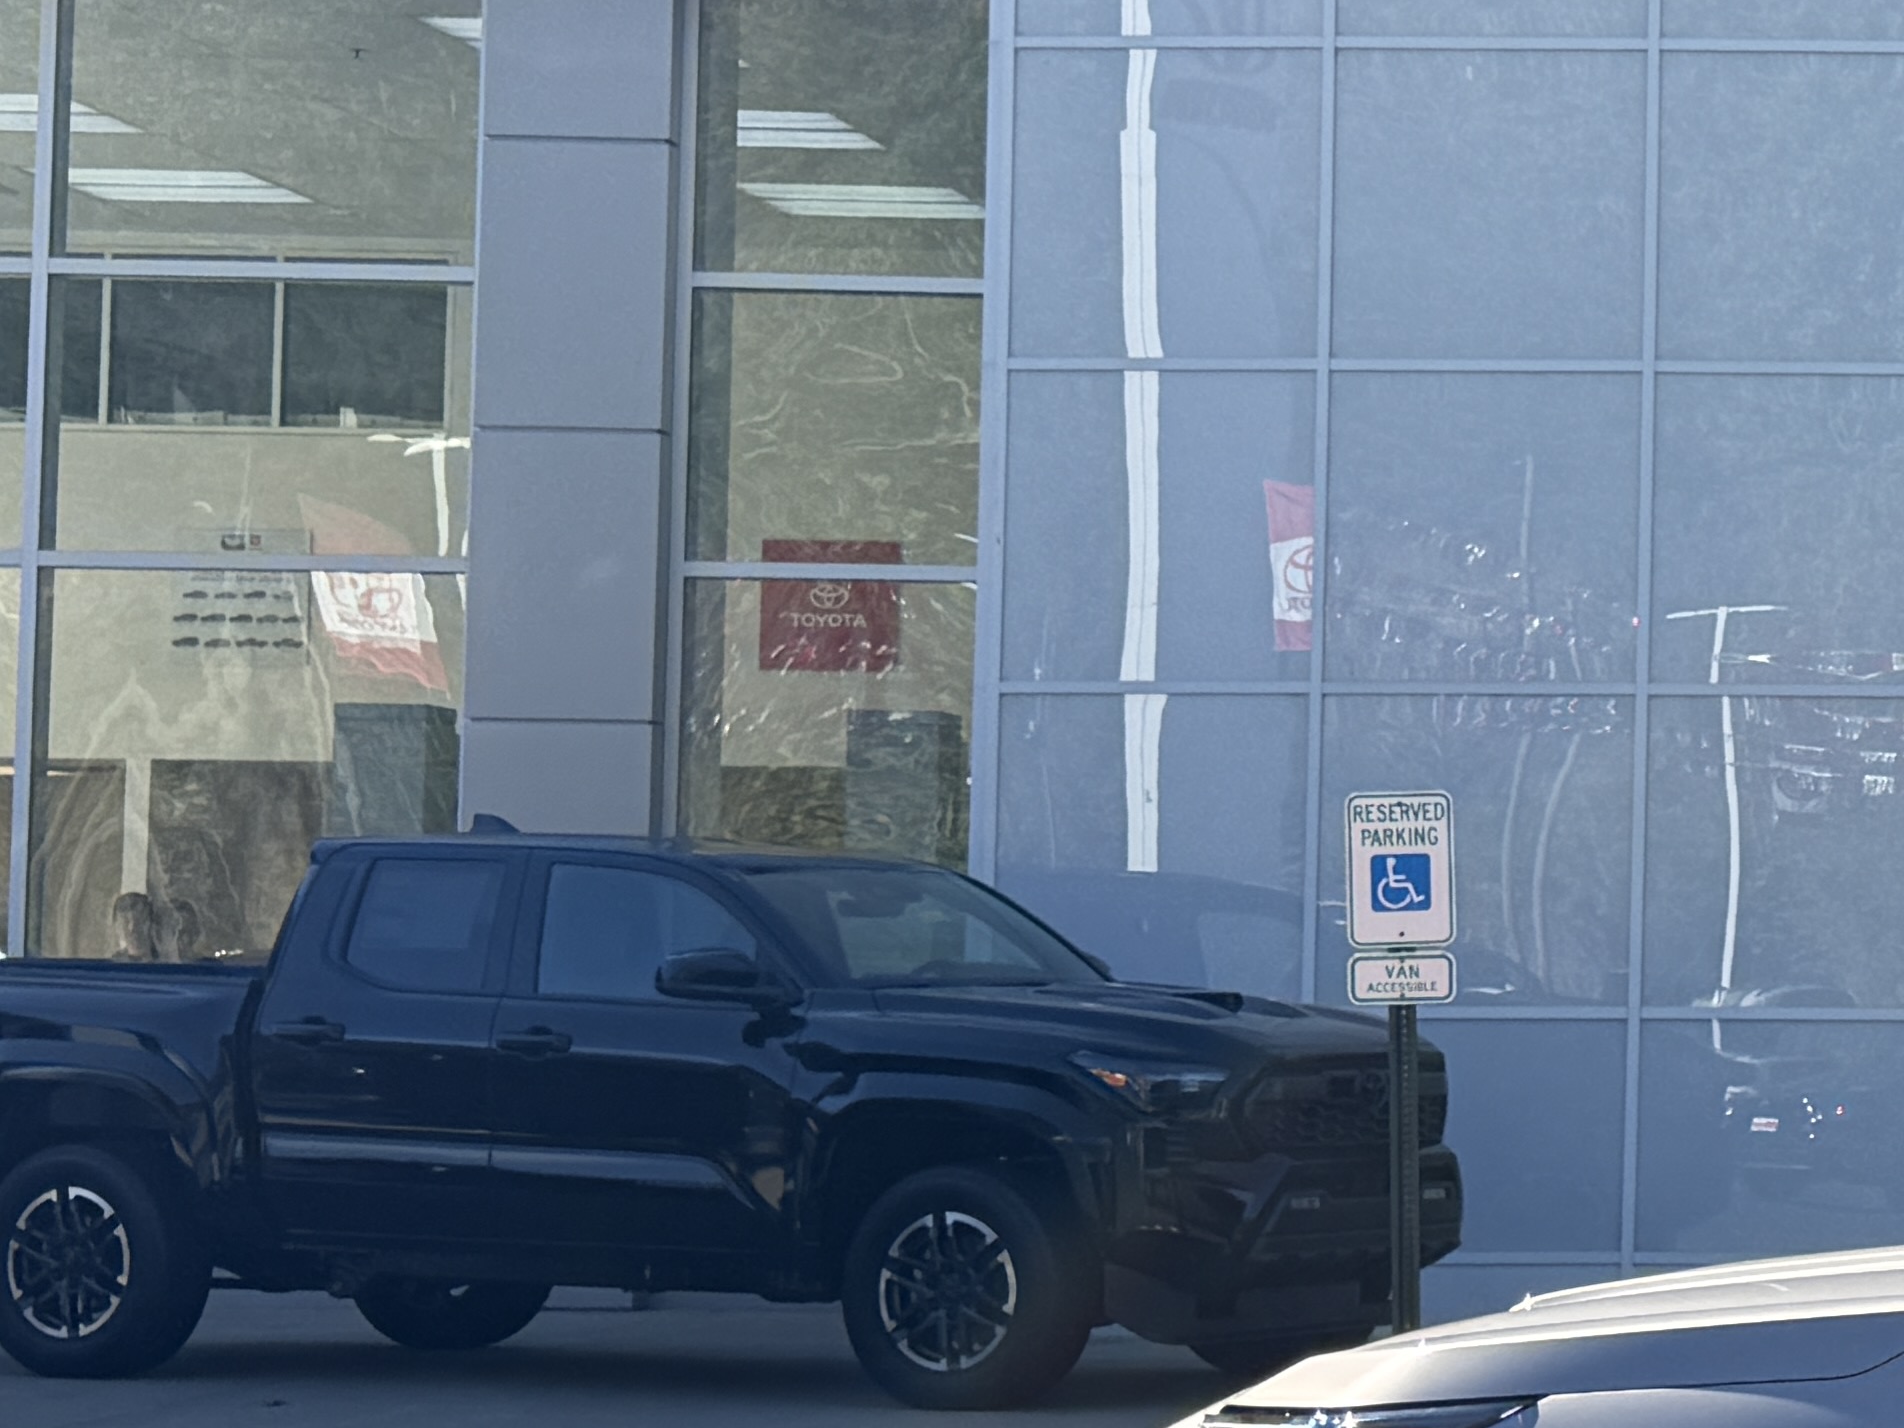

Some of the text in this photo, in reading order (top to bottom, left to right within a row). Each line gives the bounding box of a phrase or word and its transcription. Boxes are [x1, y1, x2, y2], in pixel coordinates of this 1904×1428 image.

[790, 613, 868, 628] TOYOTA
[1353, 801, 1445, 823] RESERVED
[1361, 826, 1439, 847] PARKING
[1385, 964, 1420, 979] VAN
[1366, 981, 1438, 993] ACCESSIBLE
